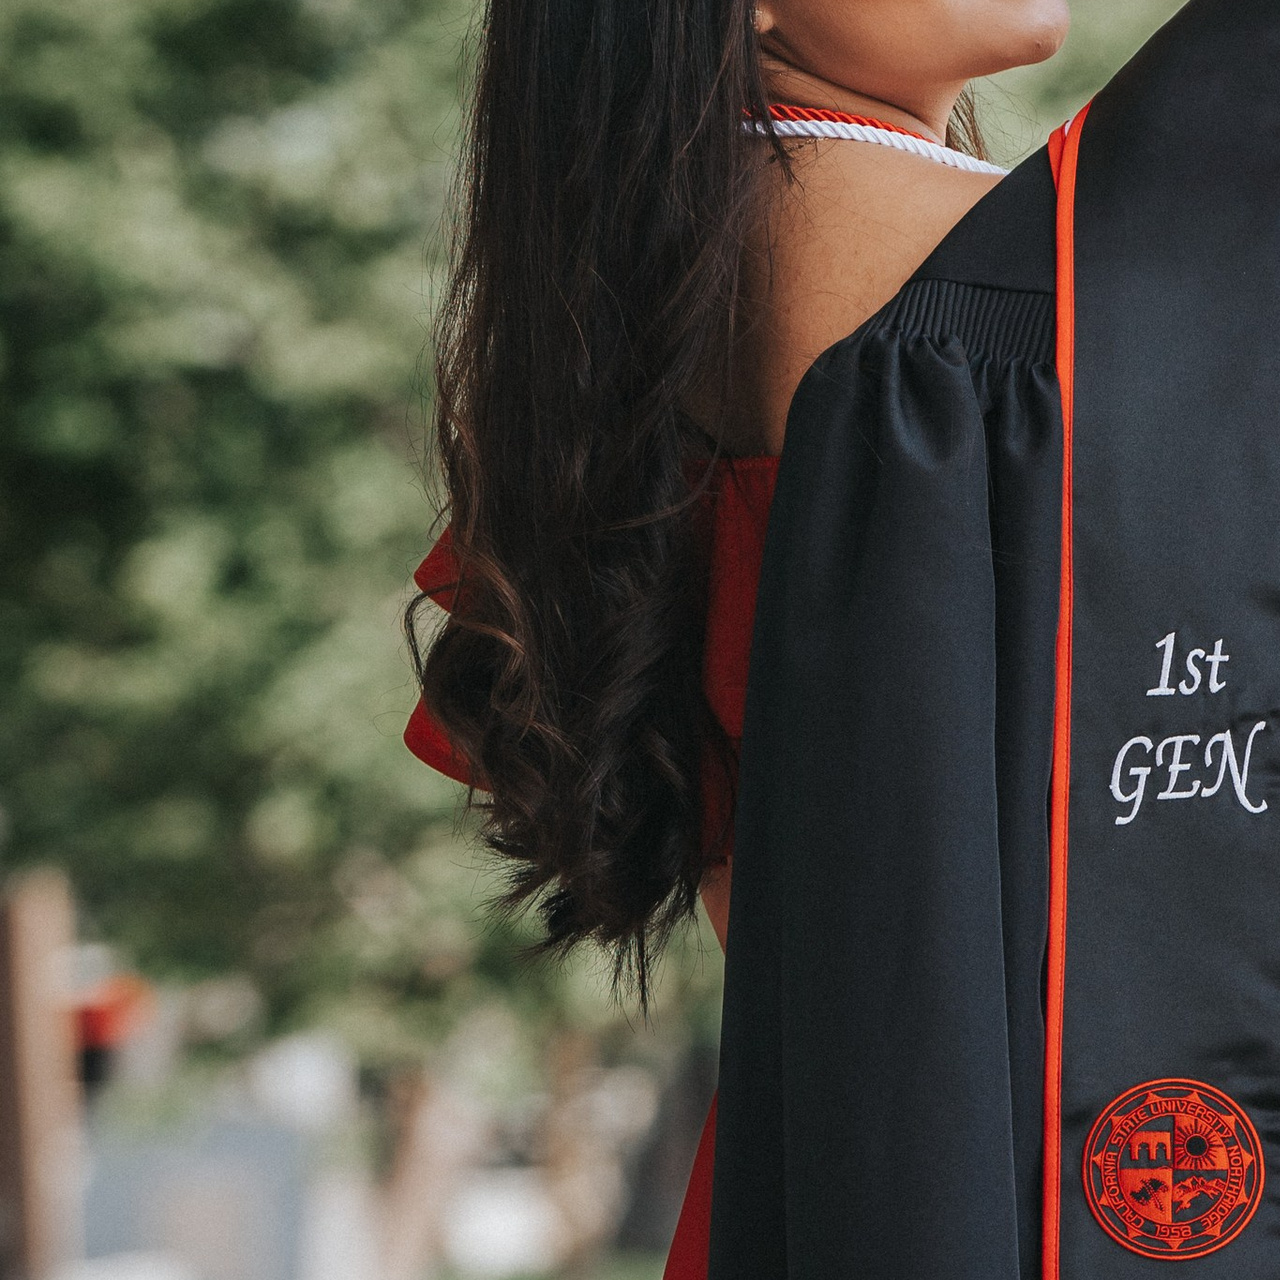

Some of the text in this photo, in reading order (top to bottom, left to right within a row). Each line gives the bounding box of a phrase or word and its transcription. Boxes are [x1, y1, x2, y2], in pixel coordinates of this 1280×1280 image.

[1146, 631, 1230, 697] 1st
[1108, 720, 1269, 826] GEN
[1111, 1109, 1149, 1148] STATE
[1103, 1151, 1145, 1230] CALIFORNIA
[1201, 1145, 1244, 1231] NORTHRIDGE
[1155, 1224, 1193, 1238] 1958
